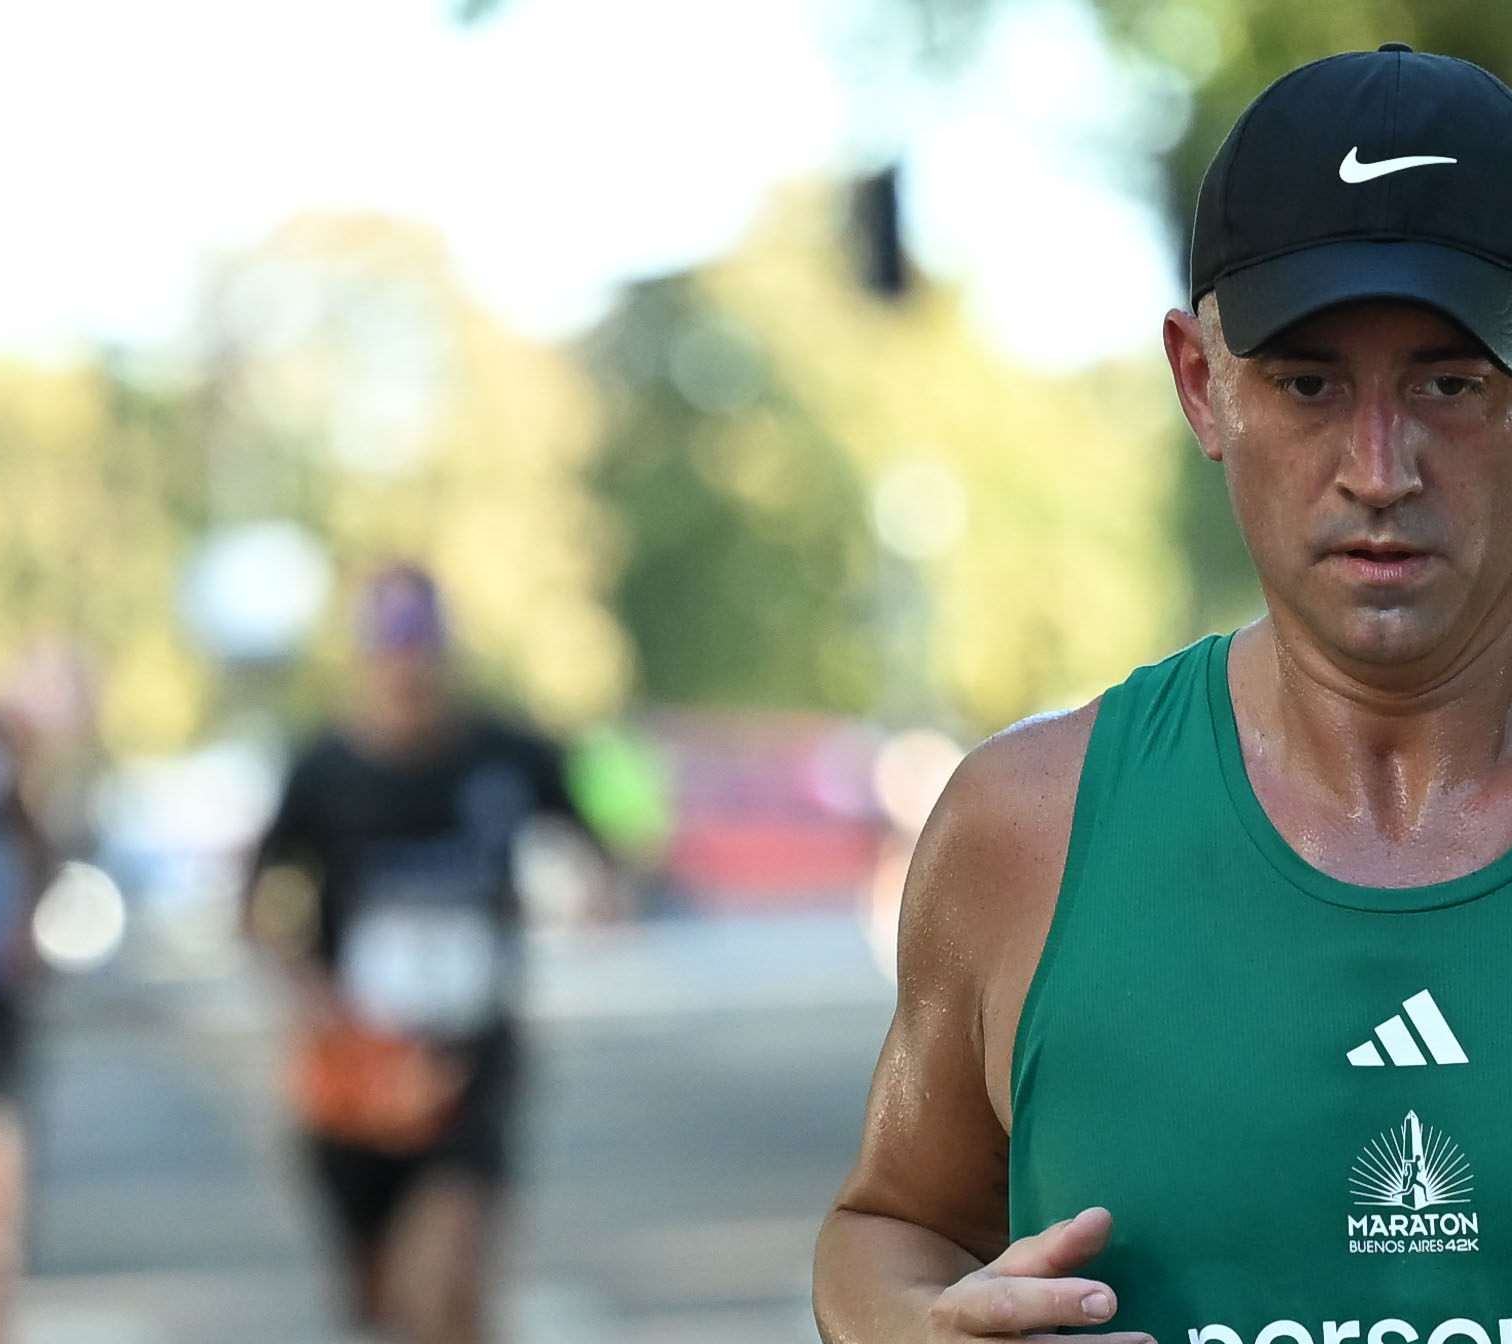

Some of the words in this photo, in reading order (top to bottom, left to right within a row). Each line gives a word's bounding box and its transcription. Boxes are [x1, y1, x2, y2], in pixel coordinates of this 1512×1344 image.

[1347, 1212, 1479, 1237] MARATON
[1349, 1240, 1405, 1253] BUENOS
[1408, 1239, 1443, 1253] AIRES
[1444, 1238, 1480, 1252] 42K
